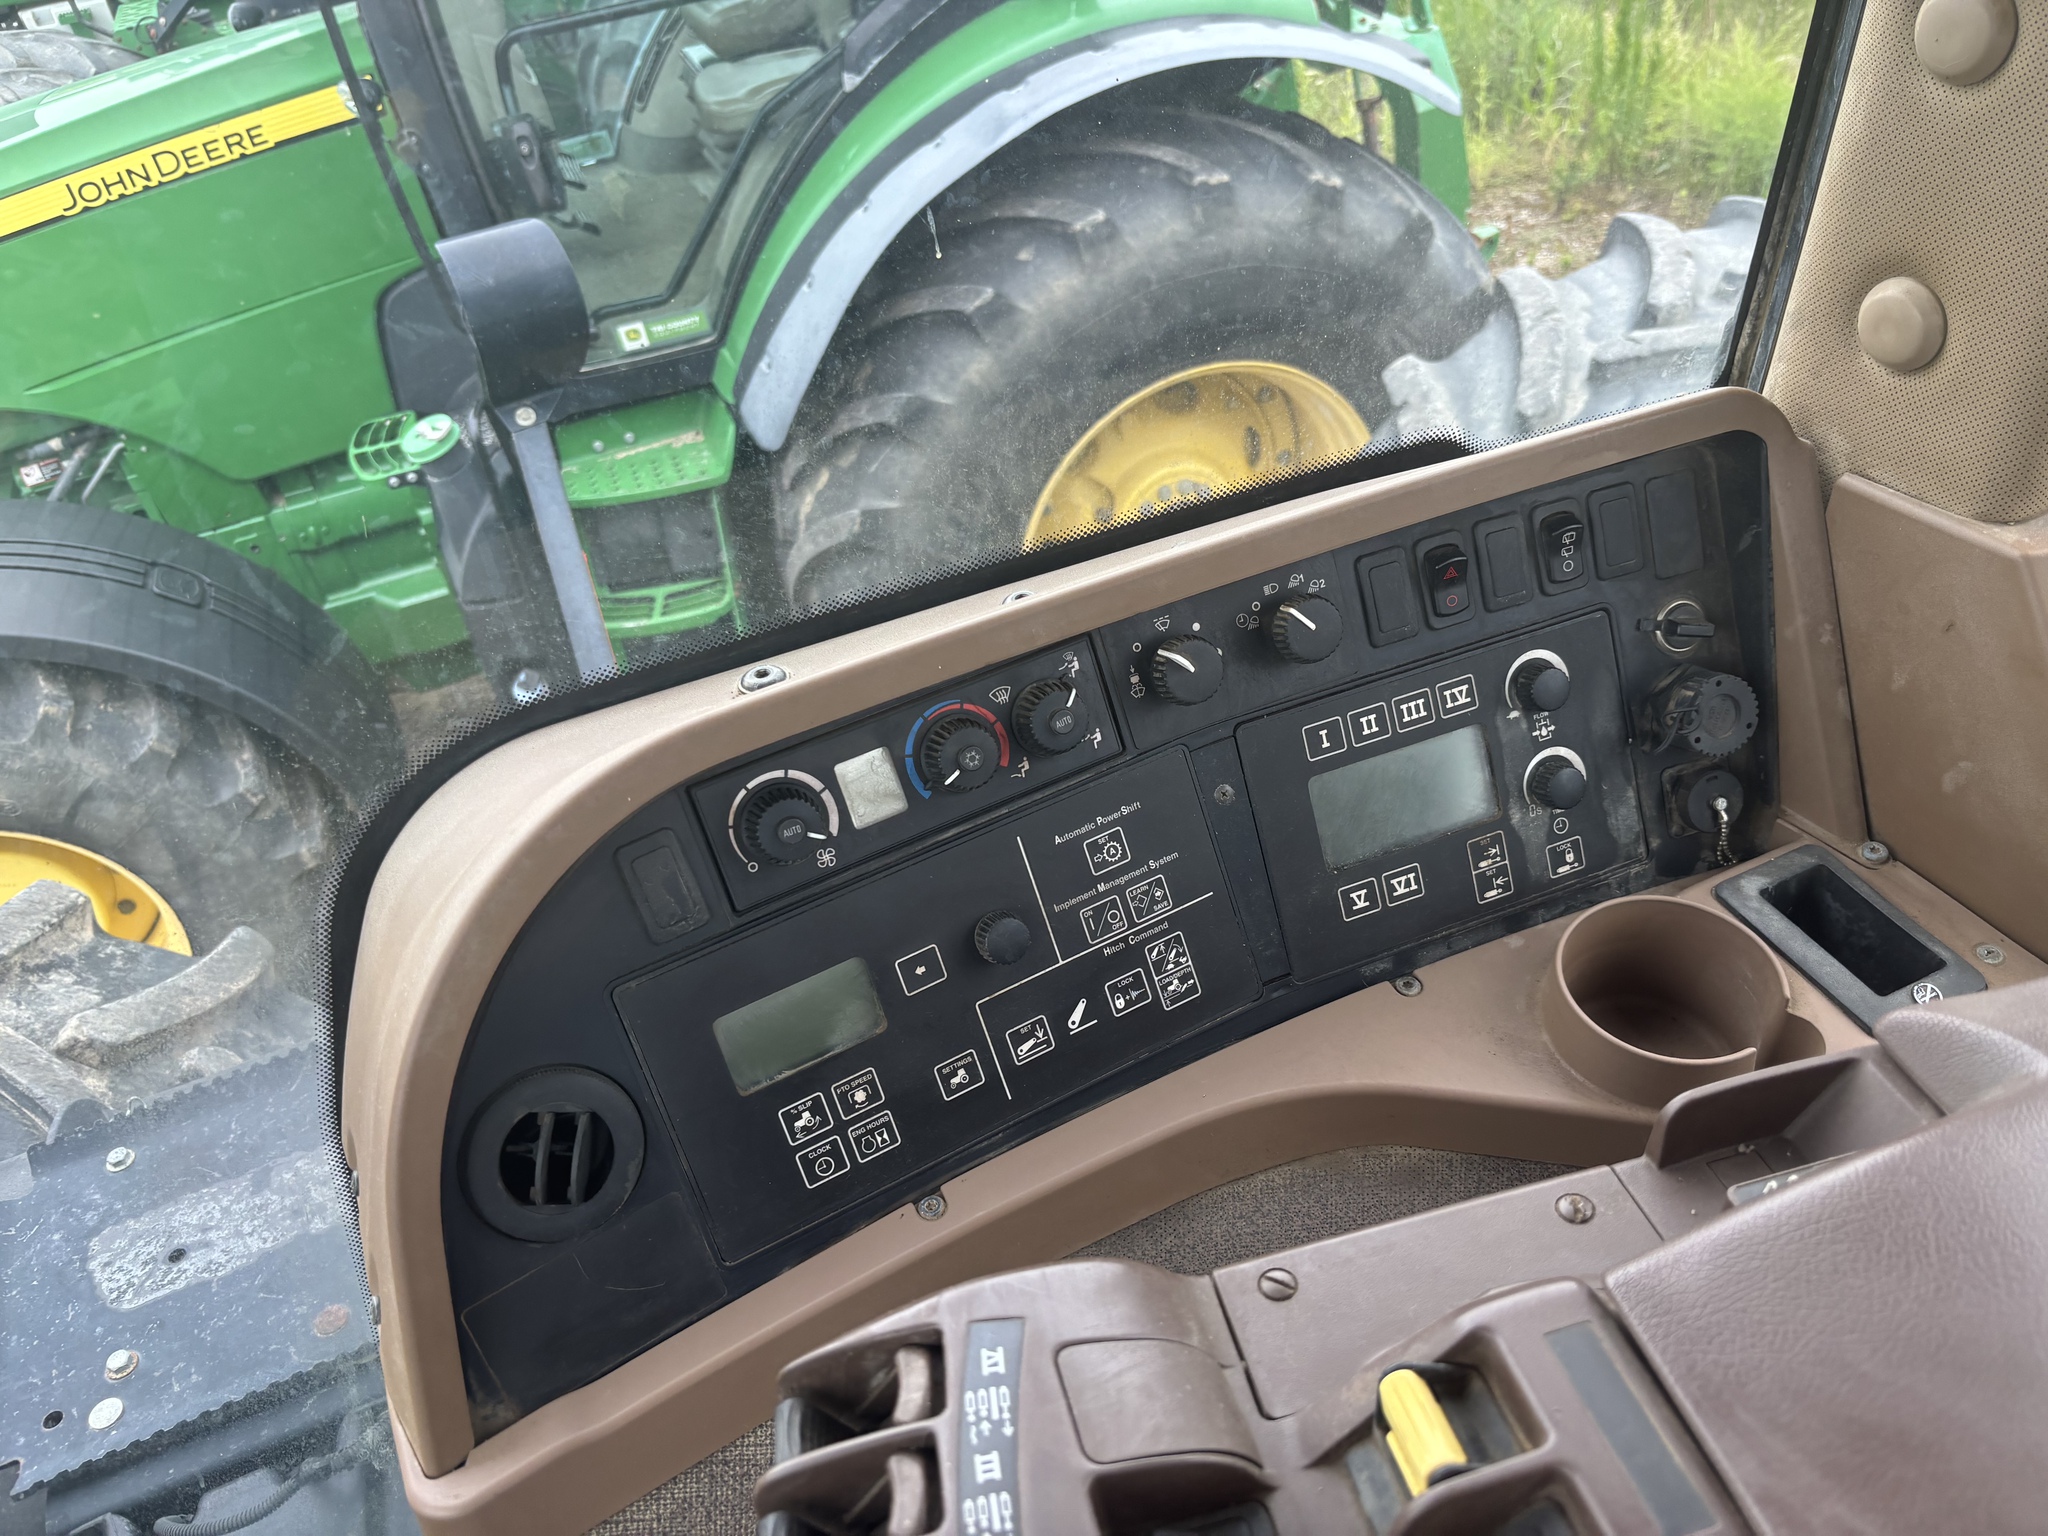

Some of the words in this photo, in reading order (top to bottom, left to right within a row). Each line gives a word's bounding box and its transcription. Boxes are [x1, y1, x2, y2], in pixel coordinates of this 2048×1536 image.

[62, 163, 152, 213] JOHN
[151, 125, 270, 179] DEERE
[1444, 684, 1472, 709] IV
[1400, 698, 1428, 723] III
[1533, 711, 1549, 720] FLOW
[1055, 715, 1072, 729] AUTO
[1359, 714, 1380, 735] II
[1319, 729, 1330, 748] I
[783, 824, 803, 838] AUTO
[1054, 822, 1096, 845] Automatic
[1096, 801, 1142, 827] PowerShift
[1097, 835, 1110, 845] SET
[1556, 843, 1572, 852] LOCK
[1485, 868, 1496, 877] SET
[1053, 889, 1098, 913] Implement
[1096, 864, 1149, 893] Management
[1149, 851, 1180, 870] System
[1390, 872, 1418, 896] VI
[1129, 884, 1150, 897] LEARN
[1152, 900, 1170, 912] SAVE
[1350, 889, 1370, 911] V
[1083, 909, 1094, 918] ON
[1111, 921, 1125, 931] OFF
[1103, 941, 1126, 957] Hitch
[1128, 921, 1169, 945] Command
[1117, 976, 1134, 988] LOCK
[1158, 967, 1192, 987] LOAD/DEPTH
[1020, 1024, 1032, 1035] SET
[942, 1055, 973, 1075] SETTINGS
[850, 1073, 873, 1089] SPEED
[797, 1100, 813, 1112] SLIP
[852, 1127, 867, 1138] ENG
[866, 1115, 890, 1131] HOURS
[808, 1143, 832, 1159] CLOCK
